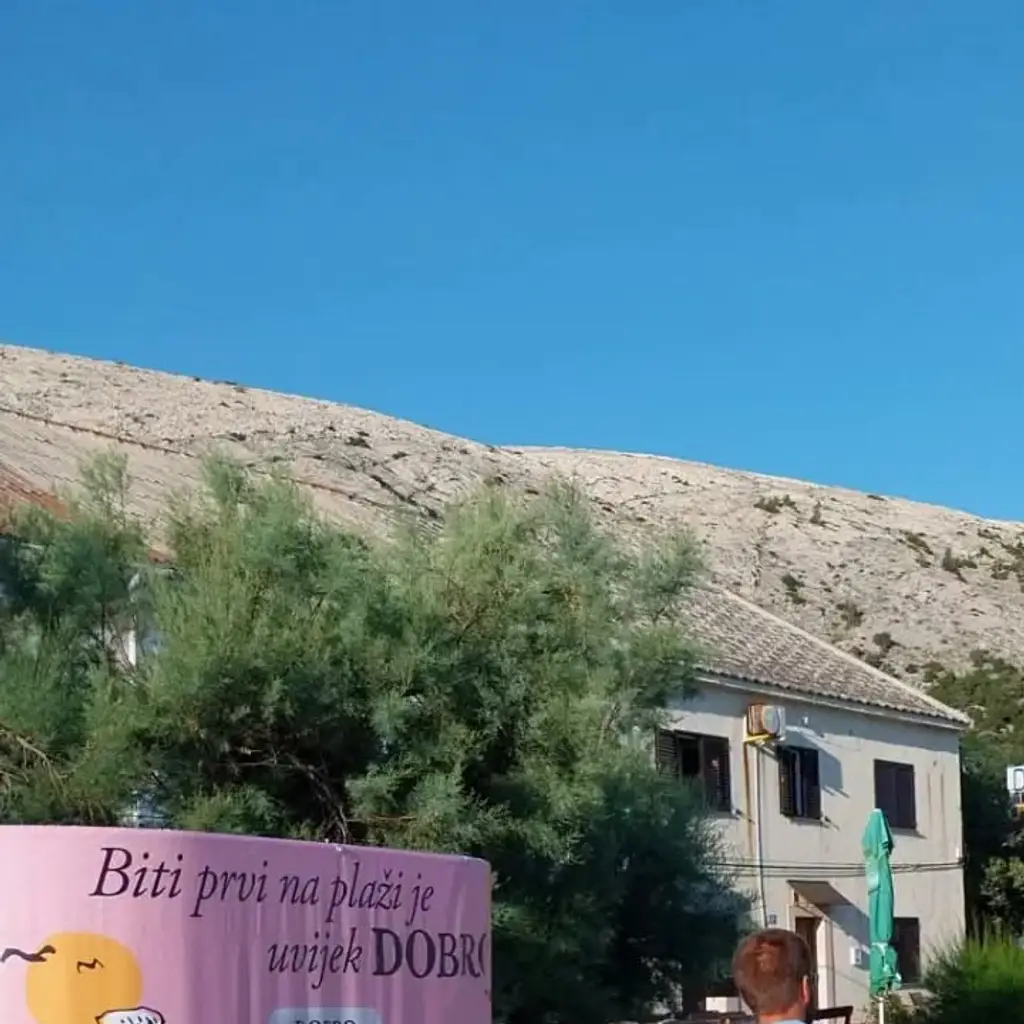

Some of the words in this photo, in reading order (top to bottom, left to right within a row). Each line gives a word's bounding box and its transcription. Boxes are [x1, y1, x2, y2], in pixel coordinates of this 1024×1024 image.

[89, 847, 183, 899] Biti
[190, 860, 268, 917] prvi
[280, 876, 319, 903] na
[325, 862, 403, 922] plaži
[406, 873, 436, 925] je
[267, 928, 362, 990] uvijek
